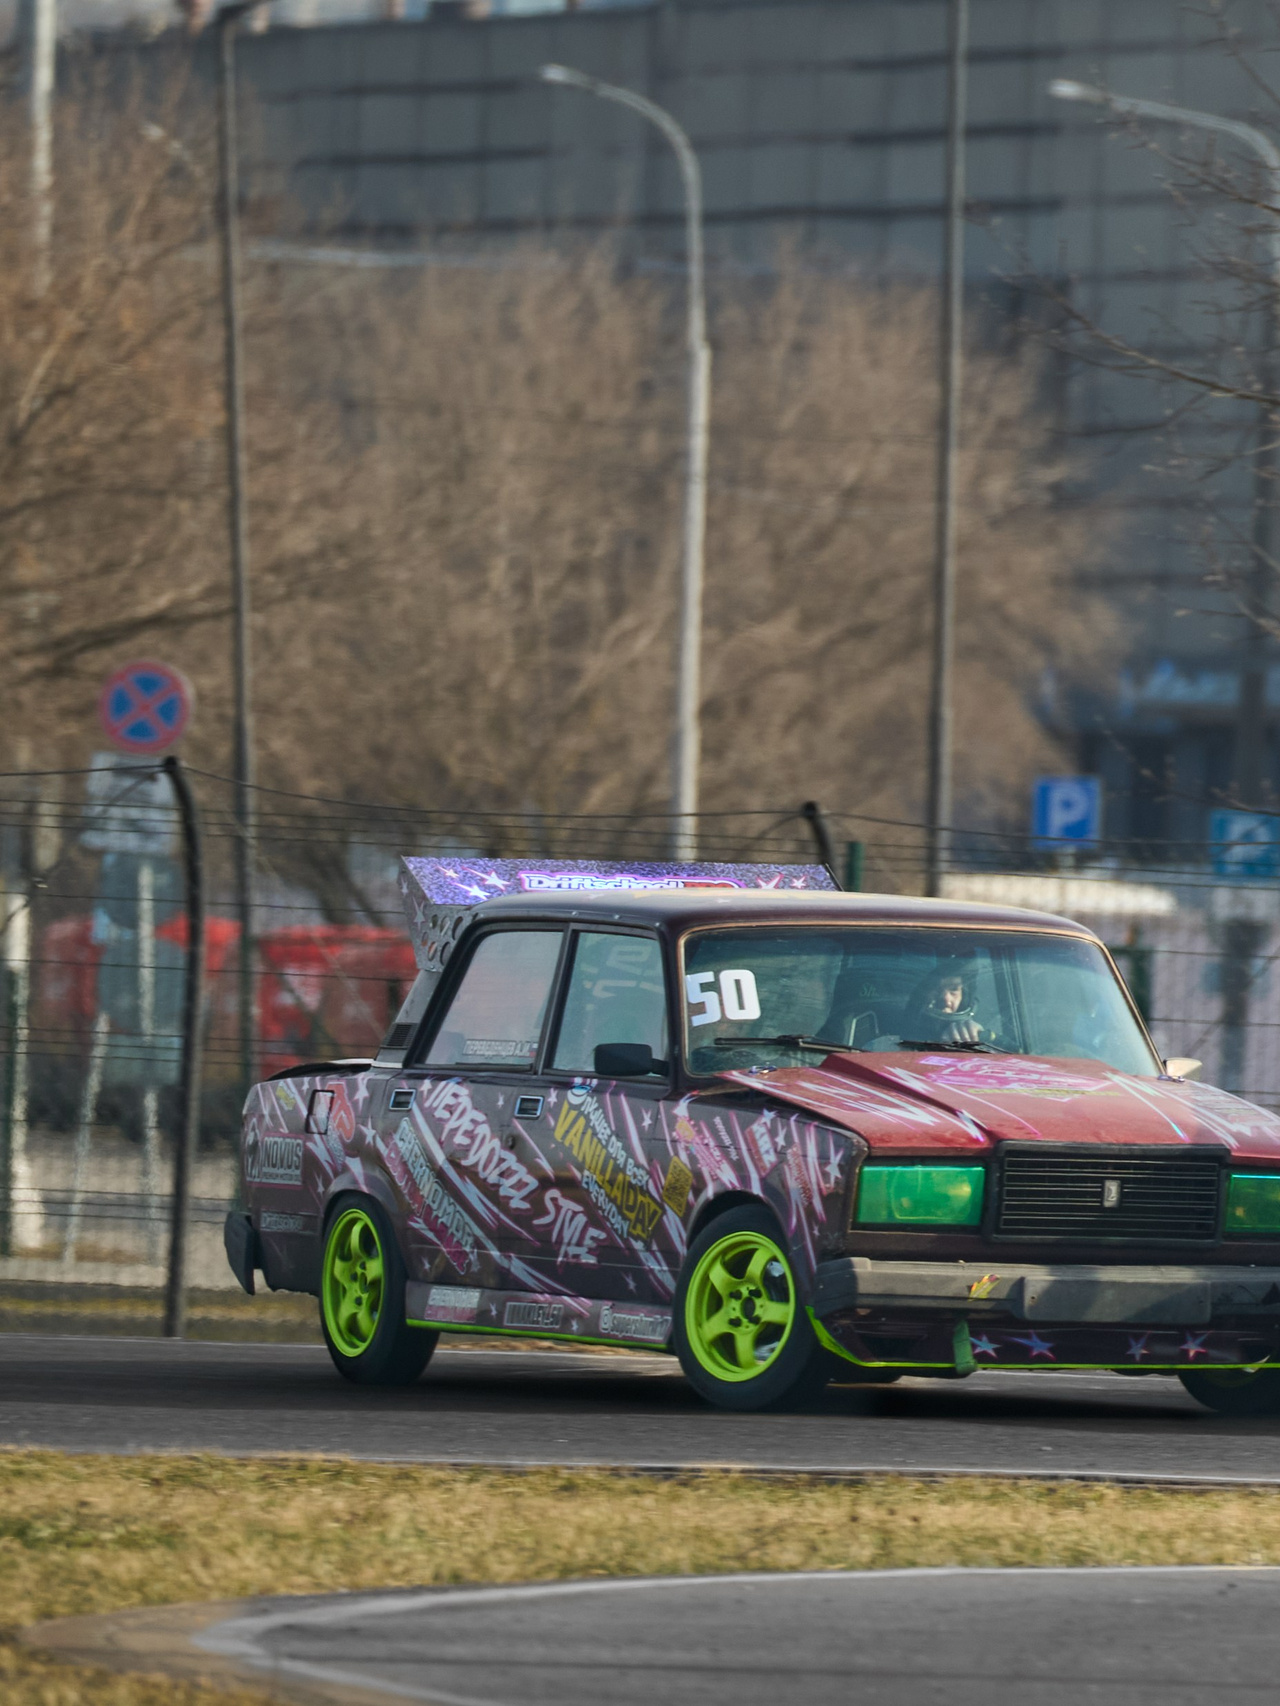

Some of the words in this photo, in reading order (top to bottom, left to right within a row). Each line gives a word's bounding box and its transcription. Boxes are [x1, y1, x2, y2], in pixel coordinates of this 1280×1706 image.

[1049, 782, 1089, 839] P
[685, 969, 761, 1027] 50
[262, 1137, 303, 1171] NOVUS
[532, 1188, 607, 1264] STYLE
[581, 1168, 630, 1239] EVERYDAY
